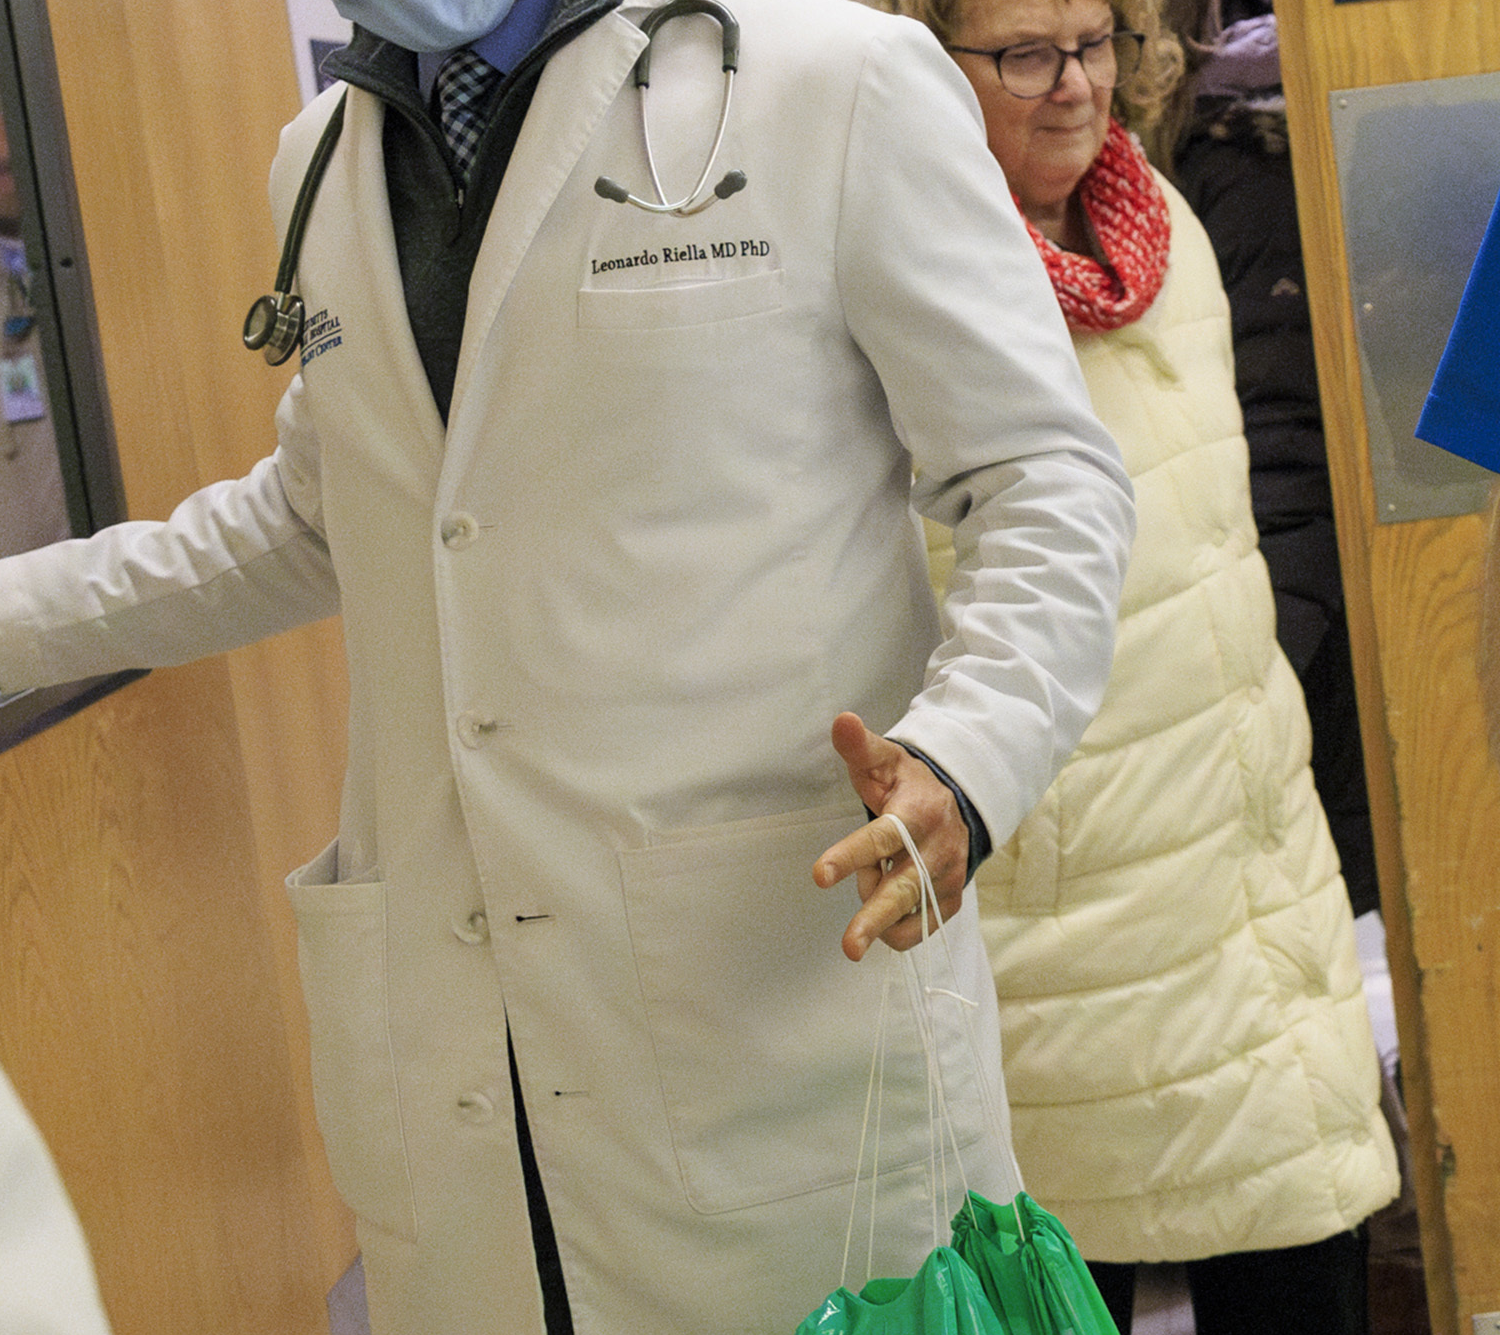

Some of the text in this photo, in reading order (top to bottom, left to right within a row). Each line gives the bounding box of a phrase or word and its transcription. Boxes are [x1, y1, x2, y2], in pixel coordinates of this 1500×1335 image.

[591, 239, 770, 275] Leonardo Riella MD PhD
